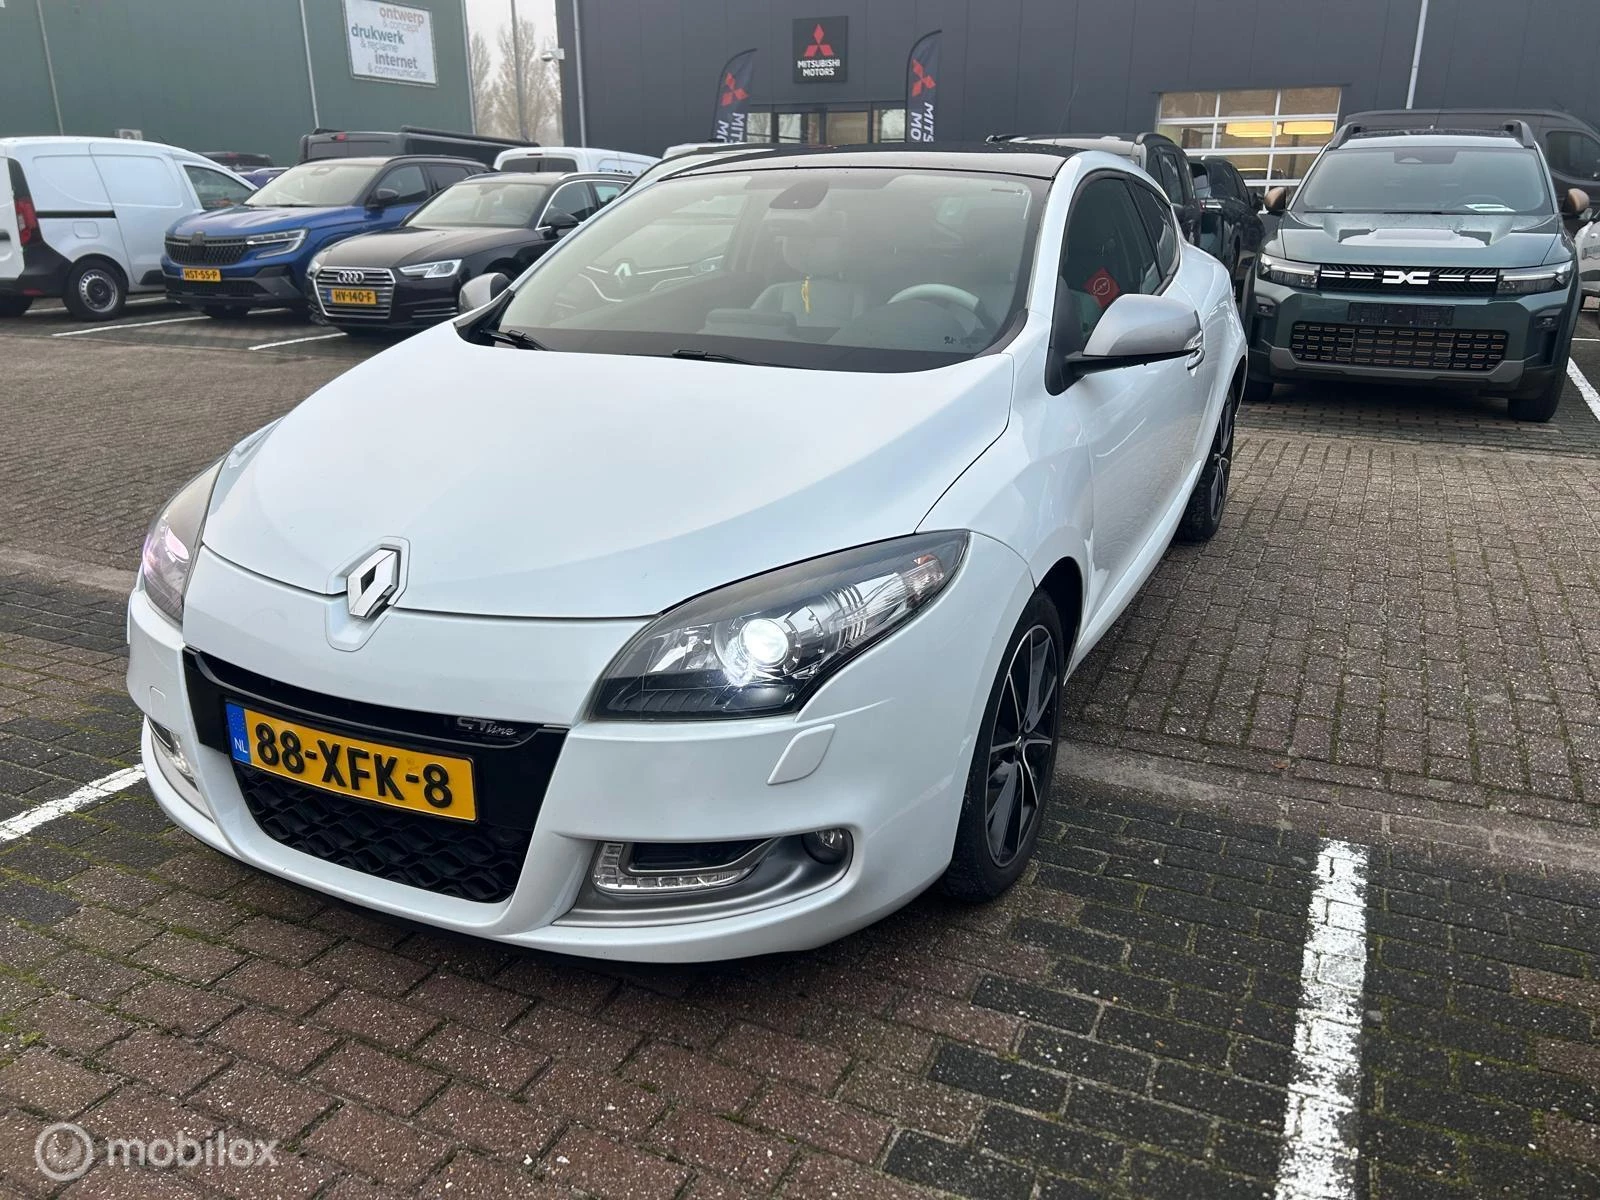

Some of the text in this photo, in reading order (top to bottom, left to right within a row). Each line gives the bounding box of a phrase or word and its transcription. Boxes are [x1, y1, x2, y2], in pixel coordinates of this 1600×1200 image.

[379, 7, 425, 26] ontwerp
[351, 23, 405, 45] drukwerk
[374, 50, 418, 69] internet
[797, 59, 841, 69] MITSUBISHI
[802, 68, 835, 77] MOTORS
[730, 112, 745, 143] MIT
[233, 738, 249, 754] NL
[255, 722, 453, 808] 88-XFK-8
